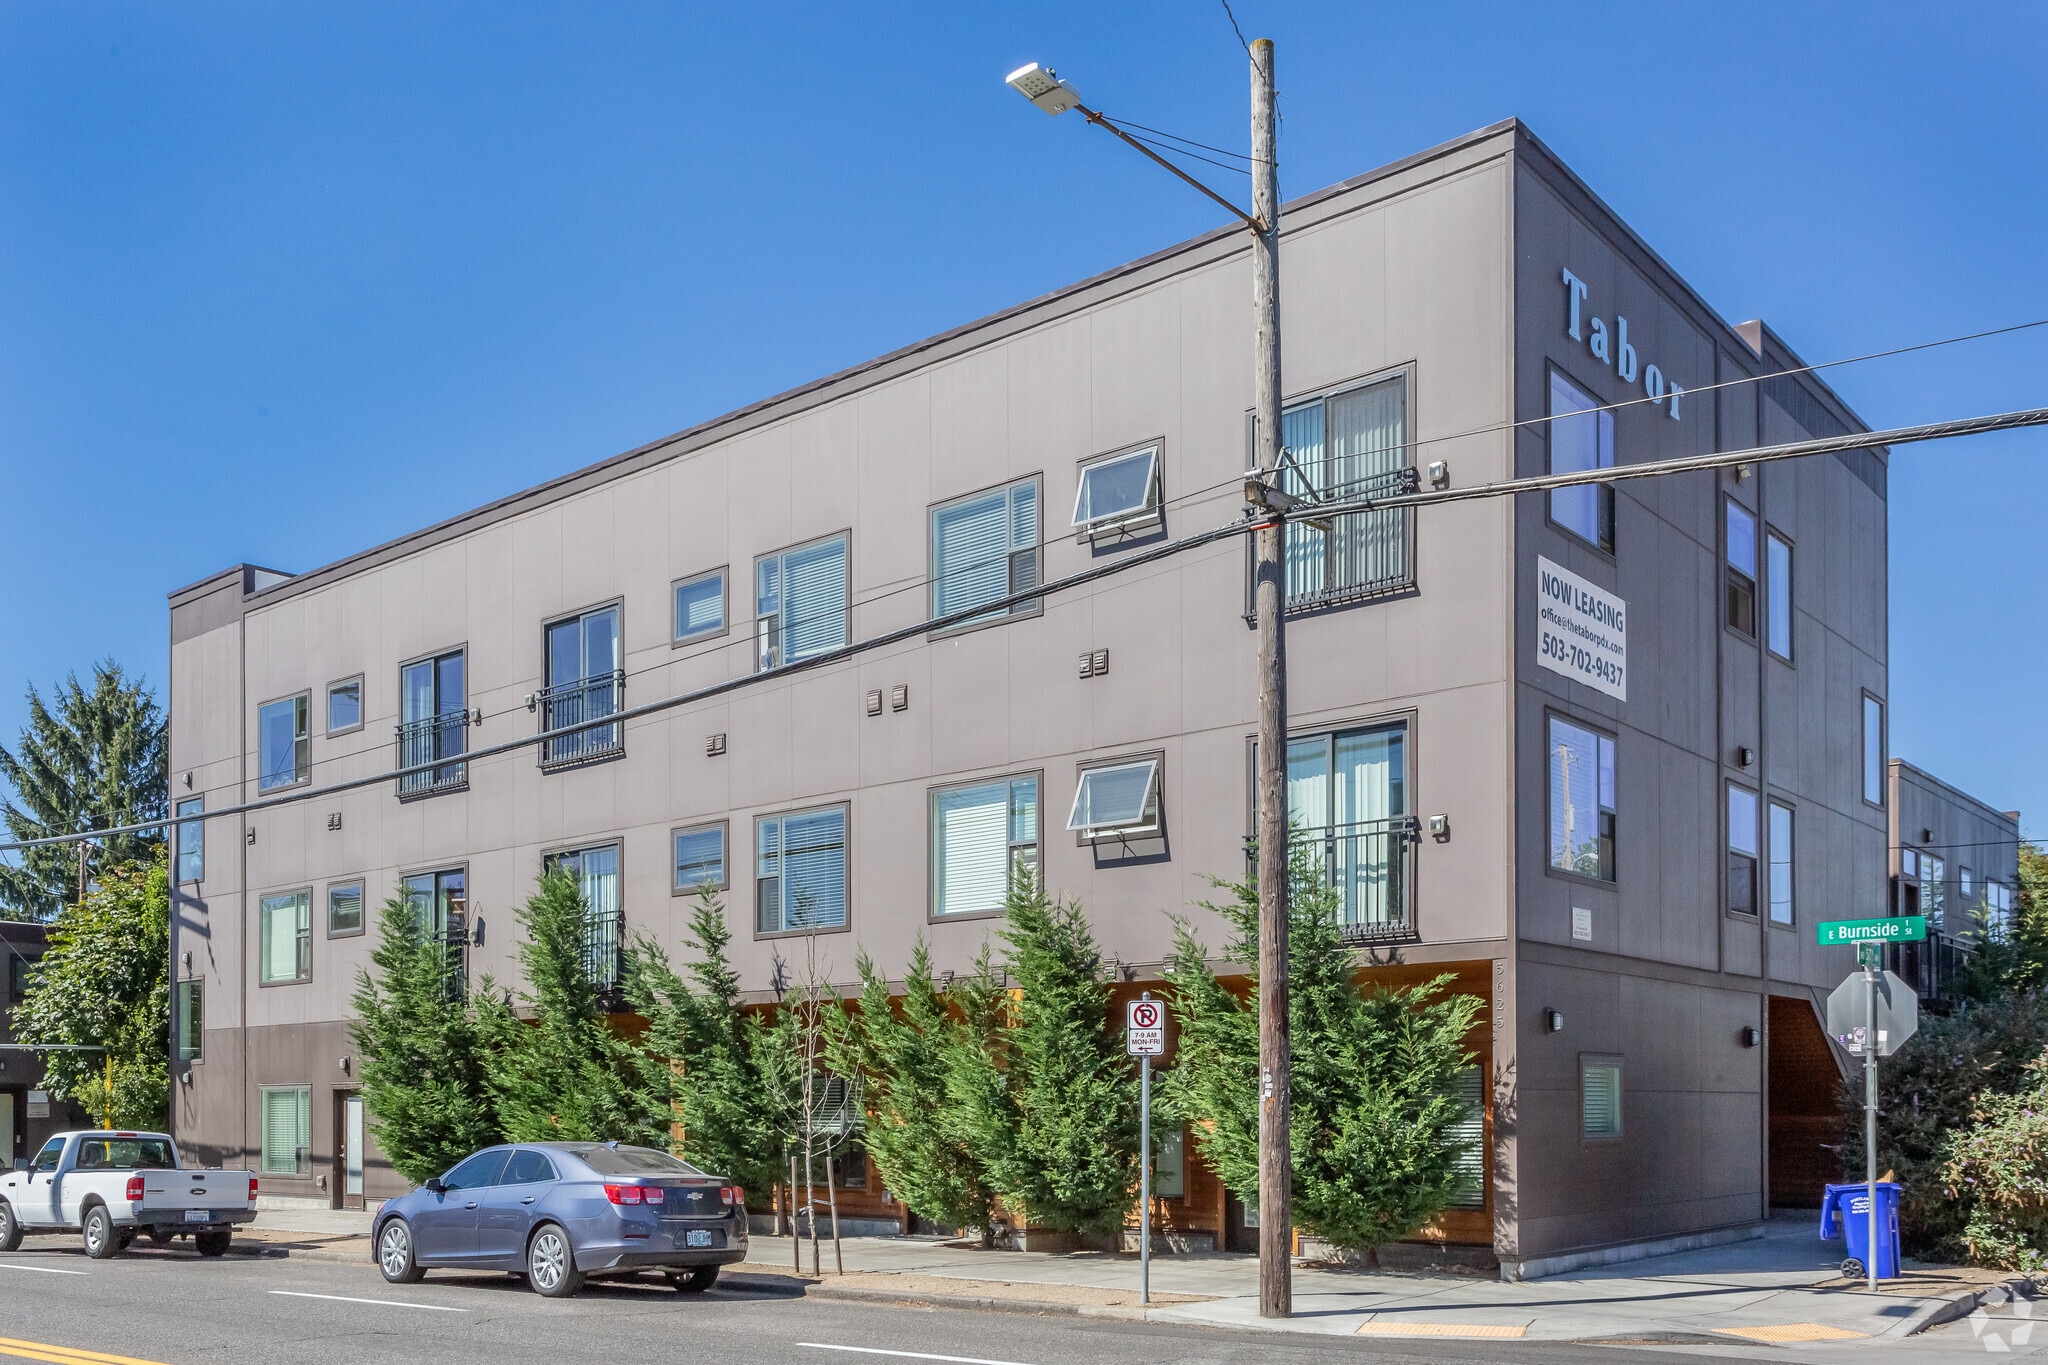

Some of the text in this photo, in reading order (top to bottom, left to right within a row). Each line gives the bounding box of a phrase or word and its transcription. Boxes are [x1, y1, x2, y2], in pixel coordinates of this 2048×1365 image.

[1563, 267, 1684, 421] Tabor
[1541, 570, 1624, 633] NOW LEASING
[1541, 607, 1624, 657] office@thetaborpdx.com
[1541, 632, 1623, 687] 503-702-9437
[1828, 930, 1834, 940] E
[1838, 922, 1899, 939] Burnside
